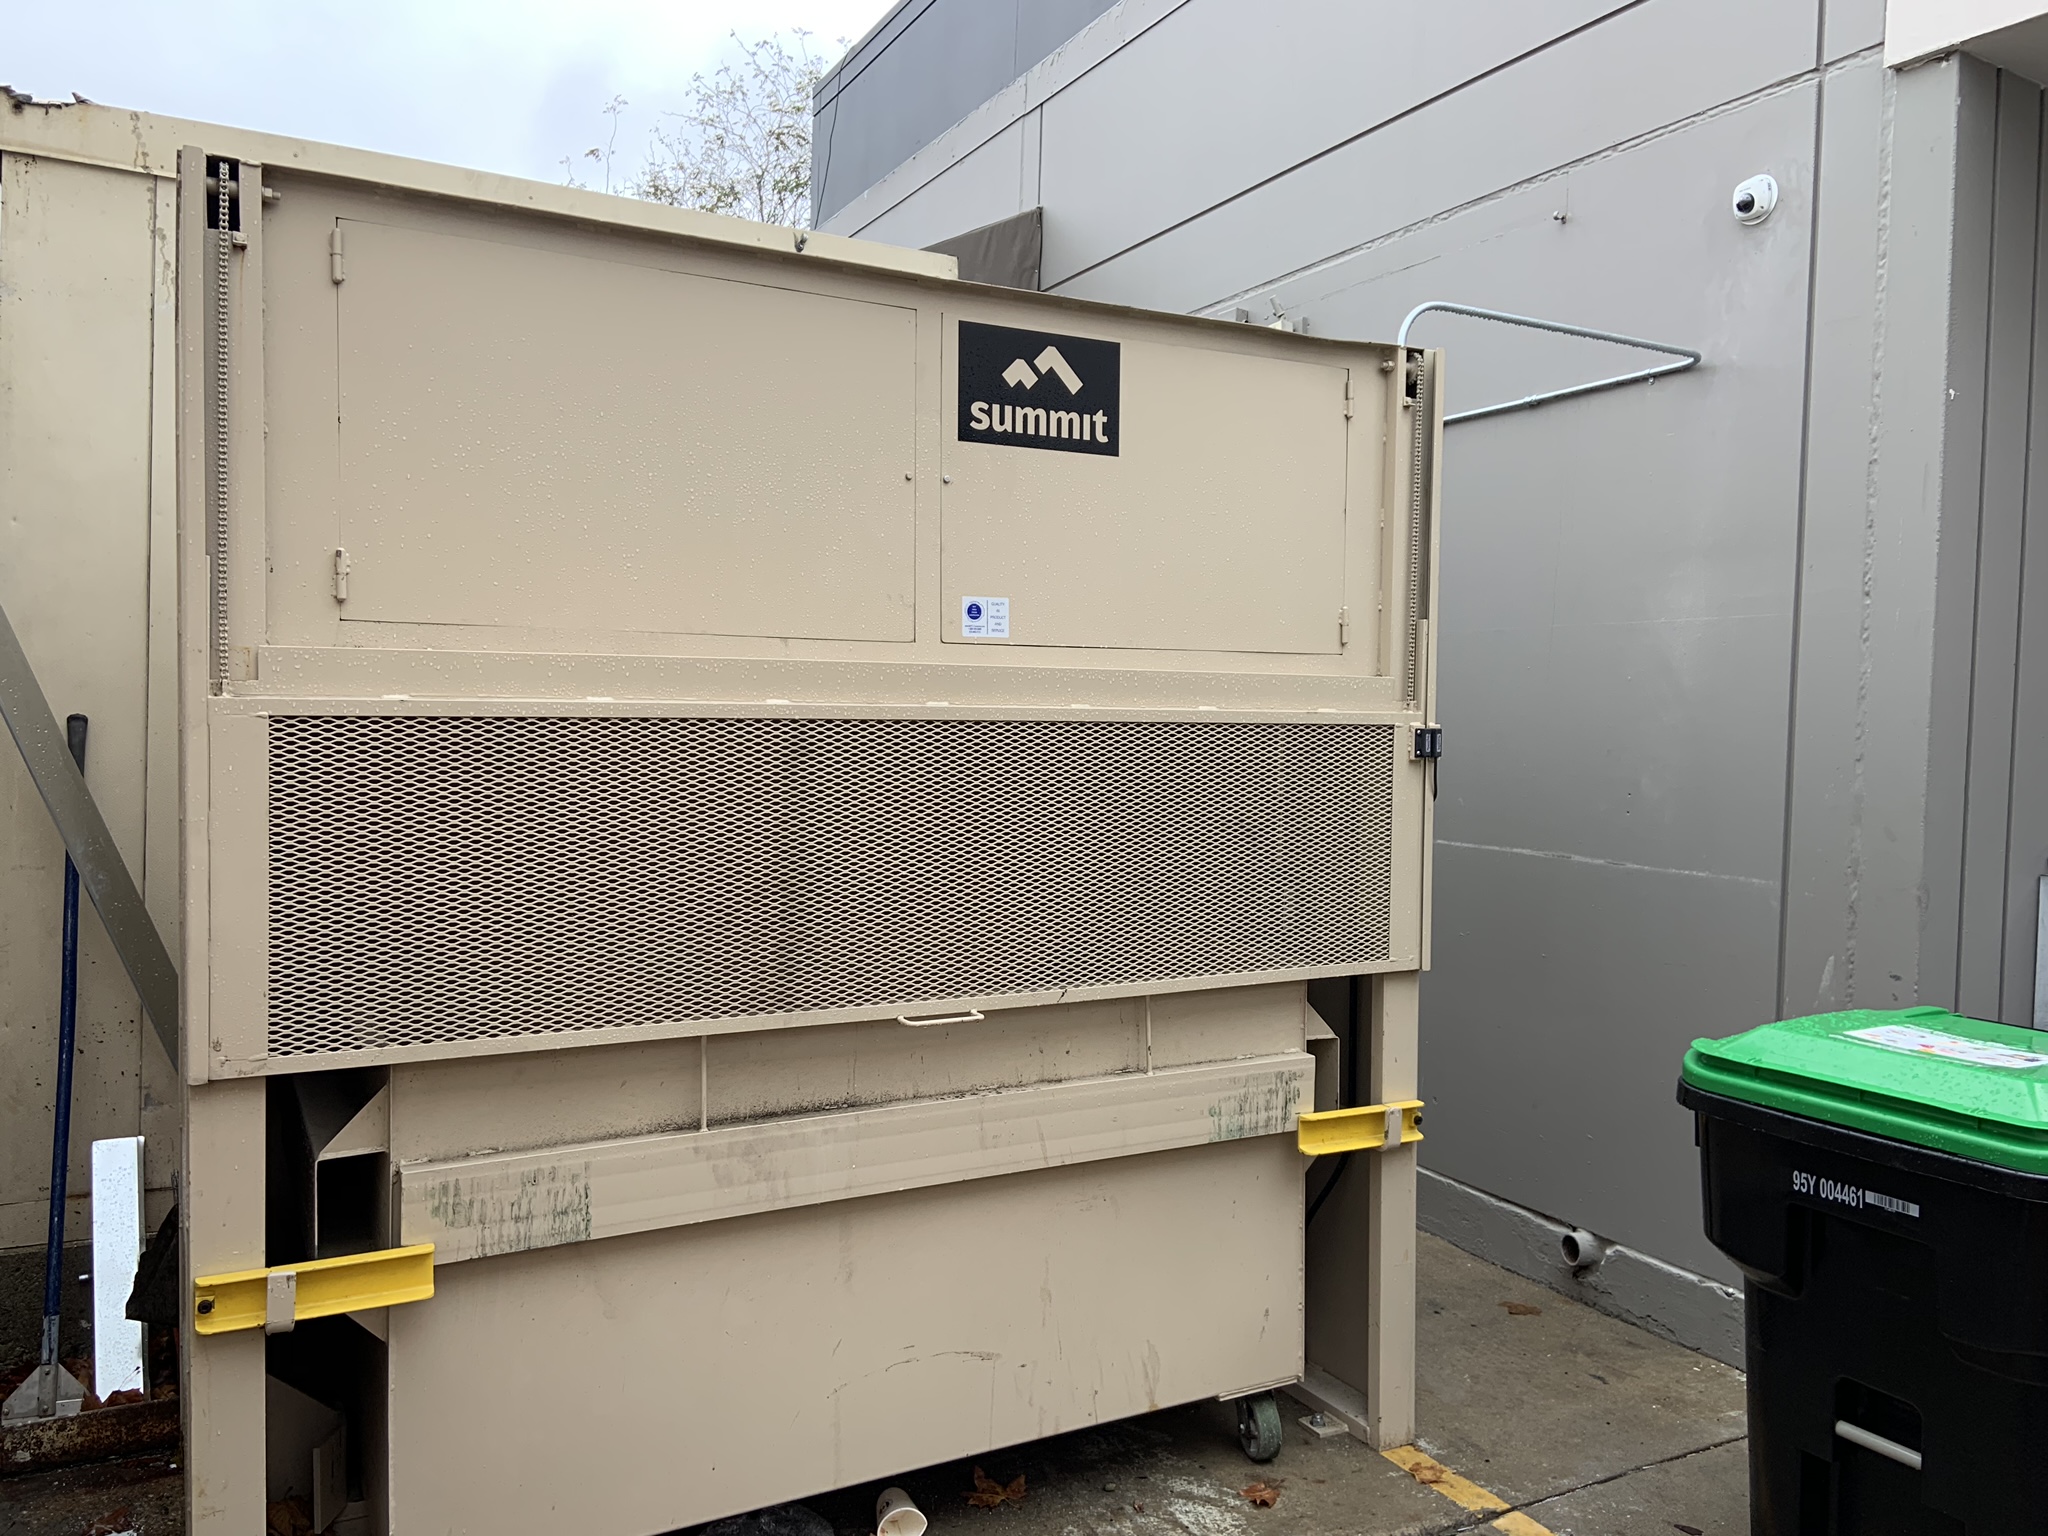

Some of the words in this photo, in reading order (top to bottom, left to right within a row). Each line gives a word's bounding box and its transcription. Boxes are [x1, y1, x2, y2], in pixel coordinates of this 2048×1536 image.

[969, 401, 1109, 443] summit
[1792, 1170, 1817, 1195] 95Y
[1819, 1177, 1863, 1209] 004461
